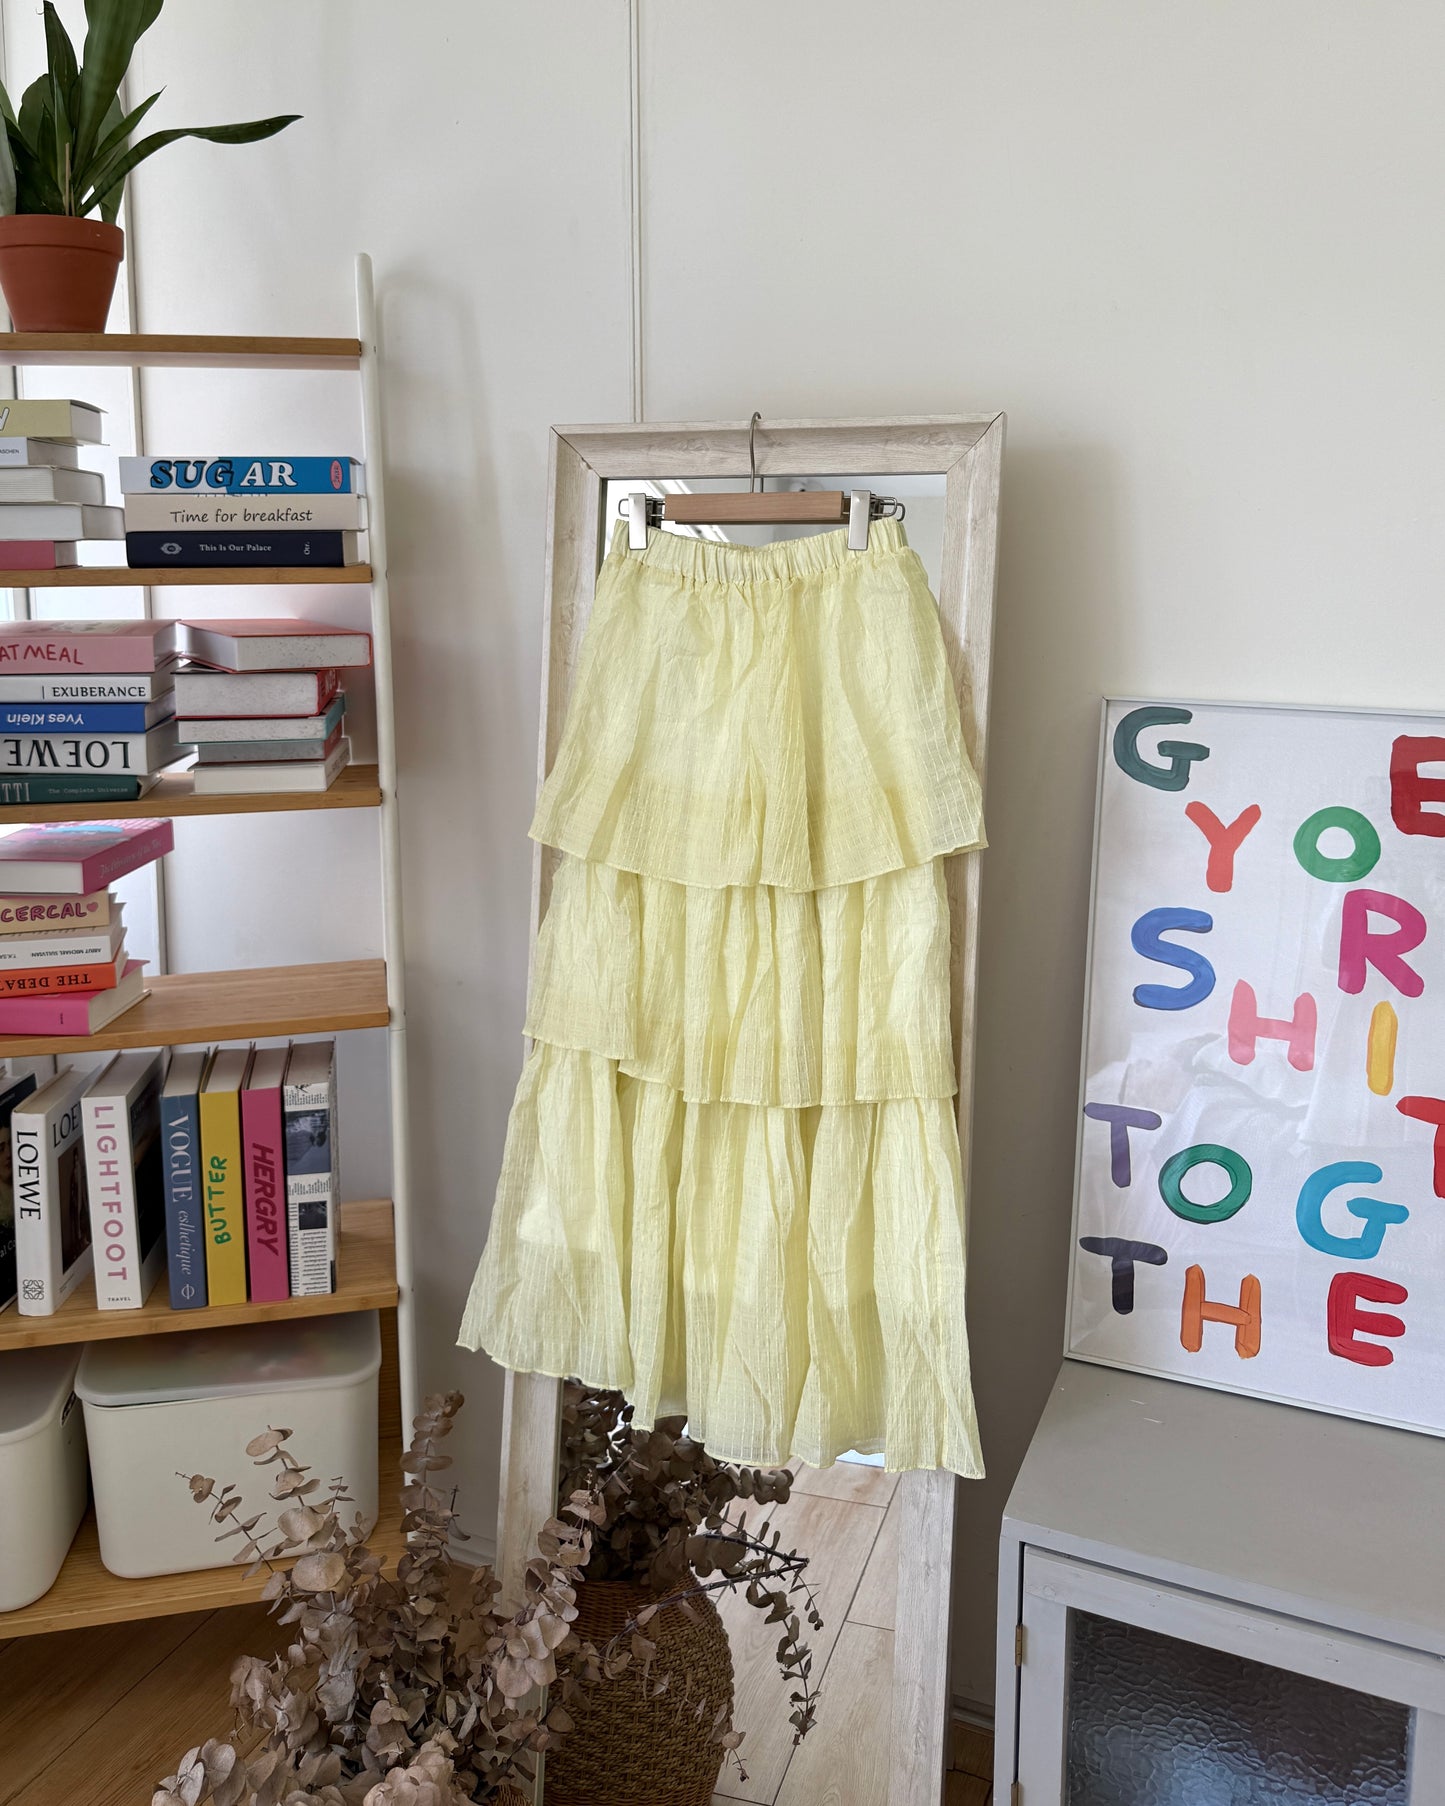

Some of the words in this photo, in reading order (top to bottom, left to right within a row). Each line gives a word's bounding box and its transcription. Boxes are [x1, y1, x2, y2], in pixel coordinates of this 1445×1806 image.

[150, 459, 298, 489] SUGAR
[170, 509, 209, 523] Time
[215, 508, 237, 522] for
[243, 508, 313, 522] breakfast
[199, 543, 217, 551] This
[219, 543, 226, 551] Is
[228, 543, 244, 551] Our
[246, 543, 272, 551] Palace
[52, 685, 146, 698] EXUBERANCE
[7, 713, 45, 725] Klein
[48, 712, 84, 725] Yves
[3, 738, 130, 769] LOEWE
[0, 782, 31, 802] TTI
[56, 973, 91, 987] THE
[52, 1101, 81, 1148] LOE
[168, 1114, 193, 1203] VOGUE
[17, 1131, 41, 1220] LOEWE
[94, 1105, 128, 1280] LIGHTFOOT
[208, 1155, 232, 1245] BUTTER
[252, 1142, 279, 1256] HERGRY
